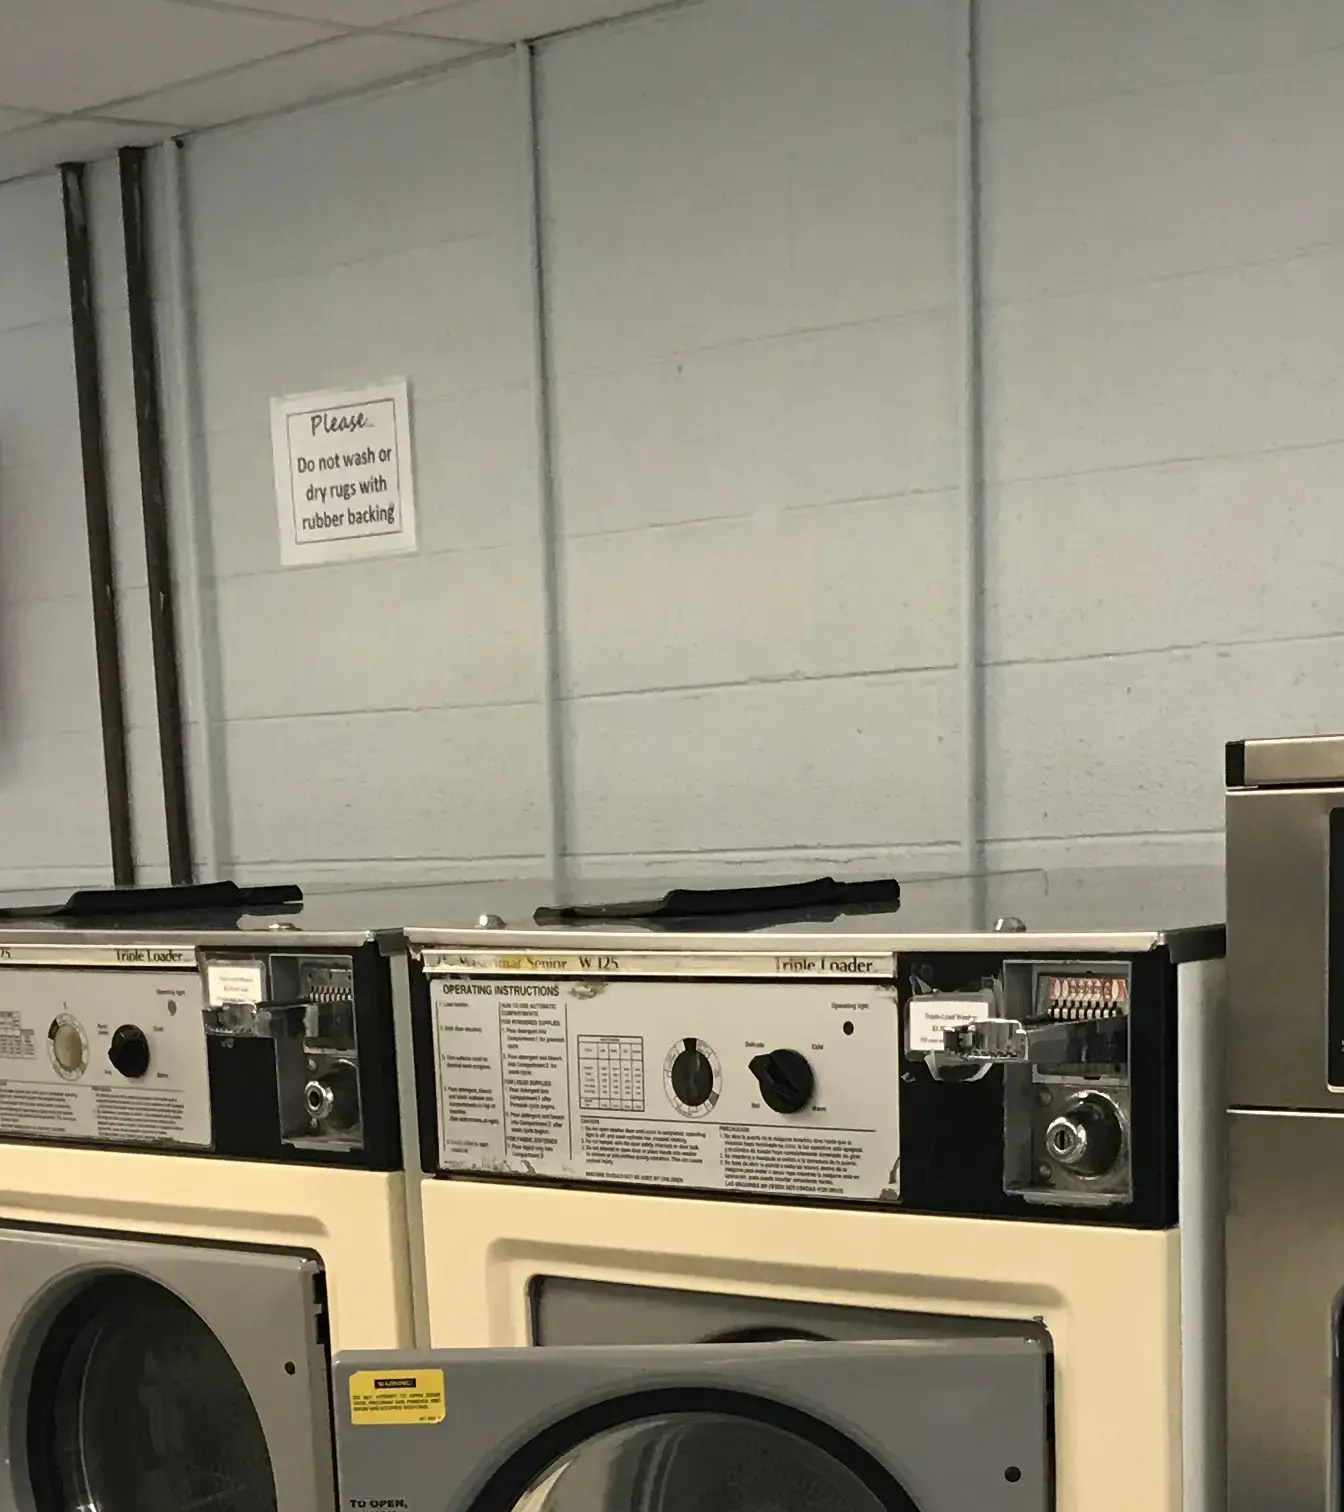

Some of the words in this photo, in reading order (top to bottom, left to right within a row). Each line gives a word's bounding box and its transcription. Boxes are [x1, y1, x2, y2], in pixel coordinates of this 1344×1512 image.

[297, 457, 315, 473] Do
[319, 453, 340, 471] not
[343, 446, 375, 467] wash
[379, 448, 392, 462] or
[306, 484, 327, 503] dry
[330, 482, 356, 500] rugs
[359, 474, 387, 494] with
[302, 511, 344, 530] rubber
[347, 503, 395, 524] backing
[114, 948, 145, 962] Triple
[145, 948, 183, 962] Loader
[442, 984, 493, 996] OPERATING
[494, 985, 560, 997] INSTRUCTIONS
[349, 1500, 367, 1508] TO
[370, 1499, 408, 1509] OPEN,
